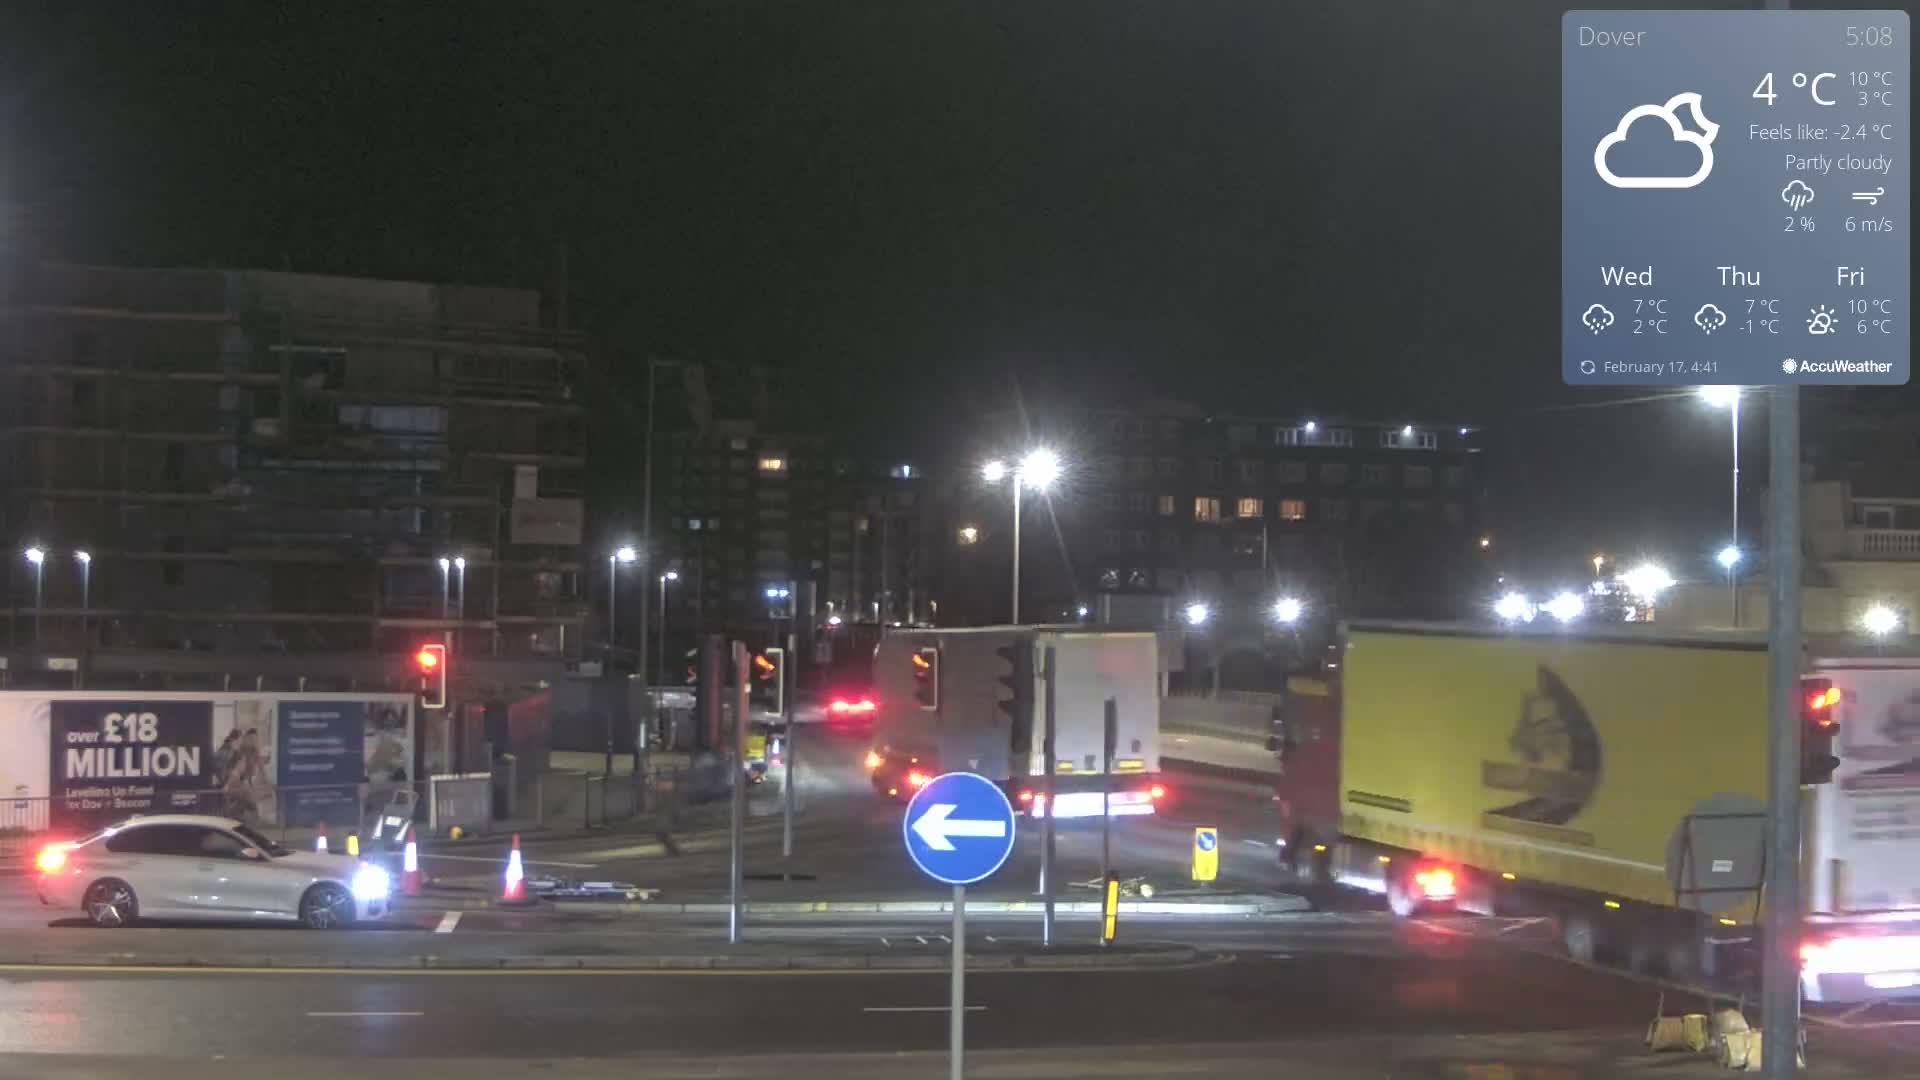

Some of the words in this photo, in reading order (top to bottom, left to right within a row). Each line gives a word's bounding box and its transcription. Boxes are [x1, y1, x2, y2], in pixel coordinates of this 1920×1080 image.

[67, 731, 99, 743] over
[104, 712, 158, 742] £18
[66, 746, 201, 779] MILLION
